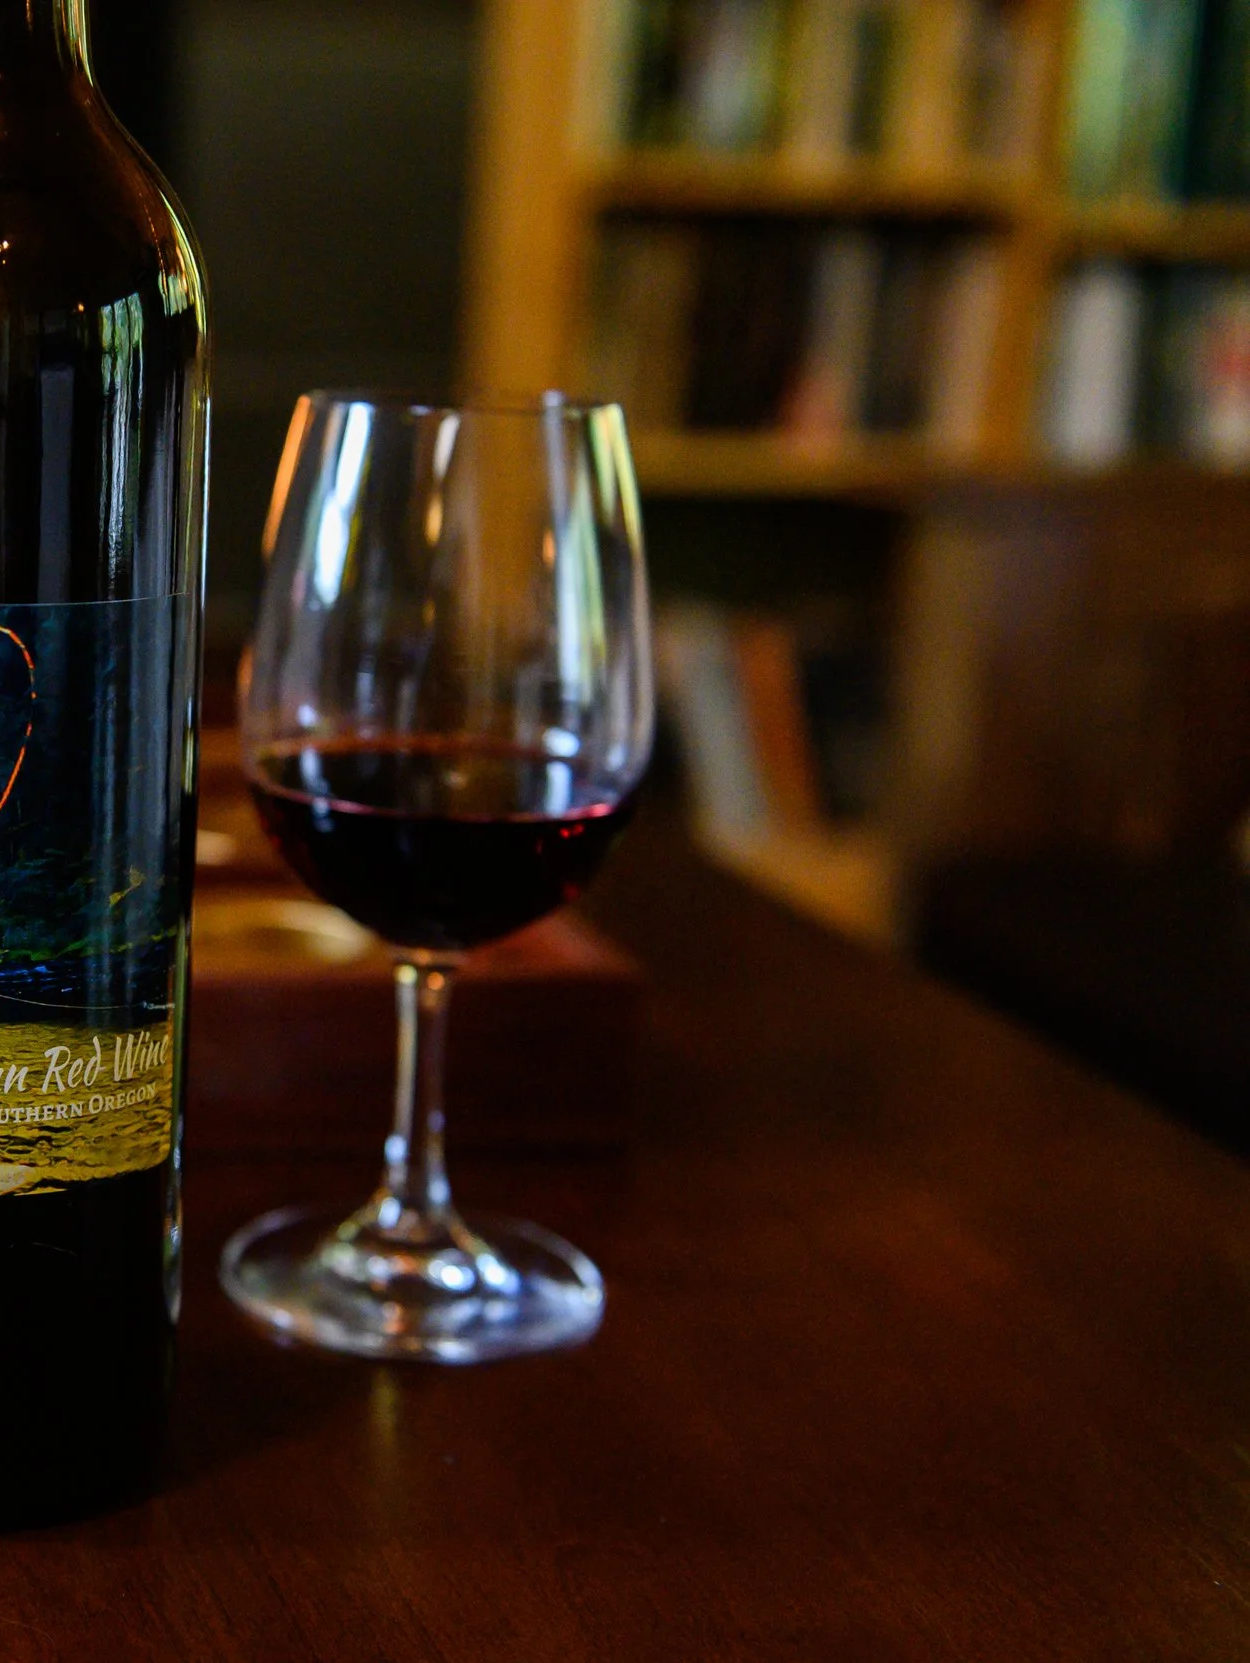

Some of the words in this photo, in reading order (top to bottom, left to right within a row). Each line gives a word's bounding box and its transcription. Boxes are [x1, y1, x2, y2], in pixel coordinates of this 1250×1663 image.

[41, 1035, 106, 1093] Red
[113, 1030, 169, 1081] Wine
[88, 1081, 157, 1114] OREGON
